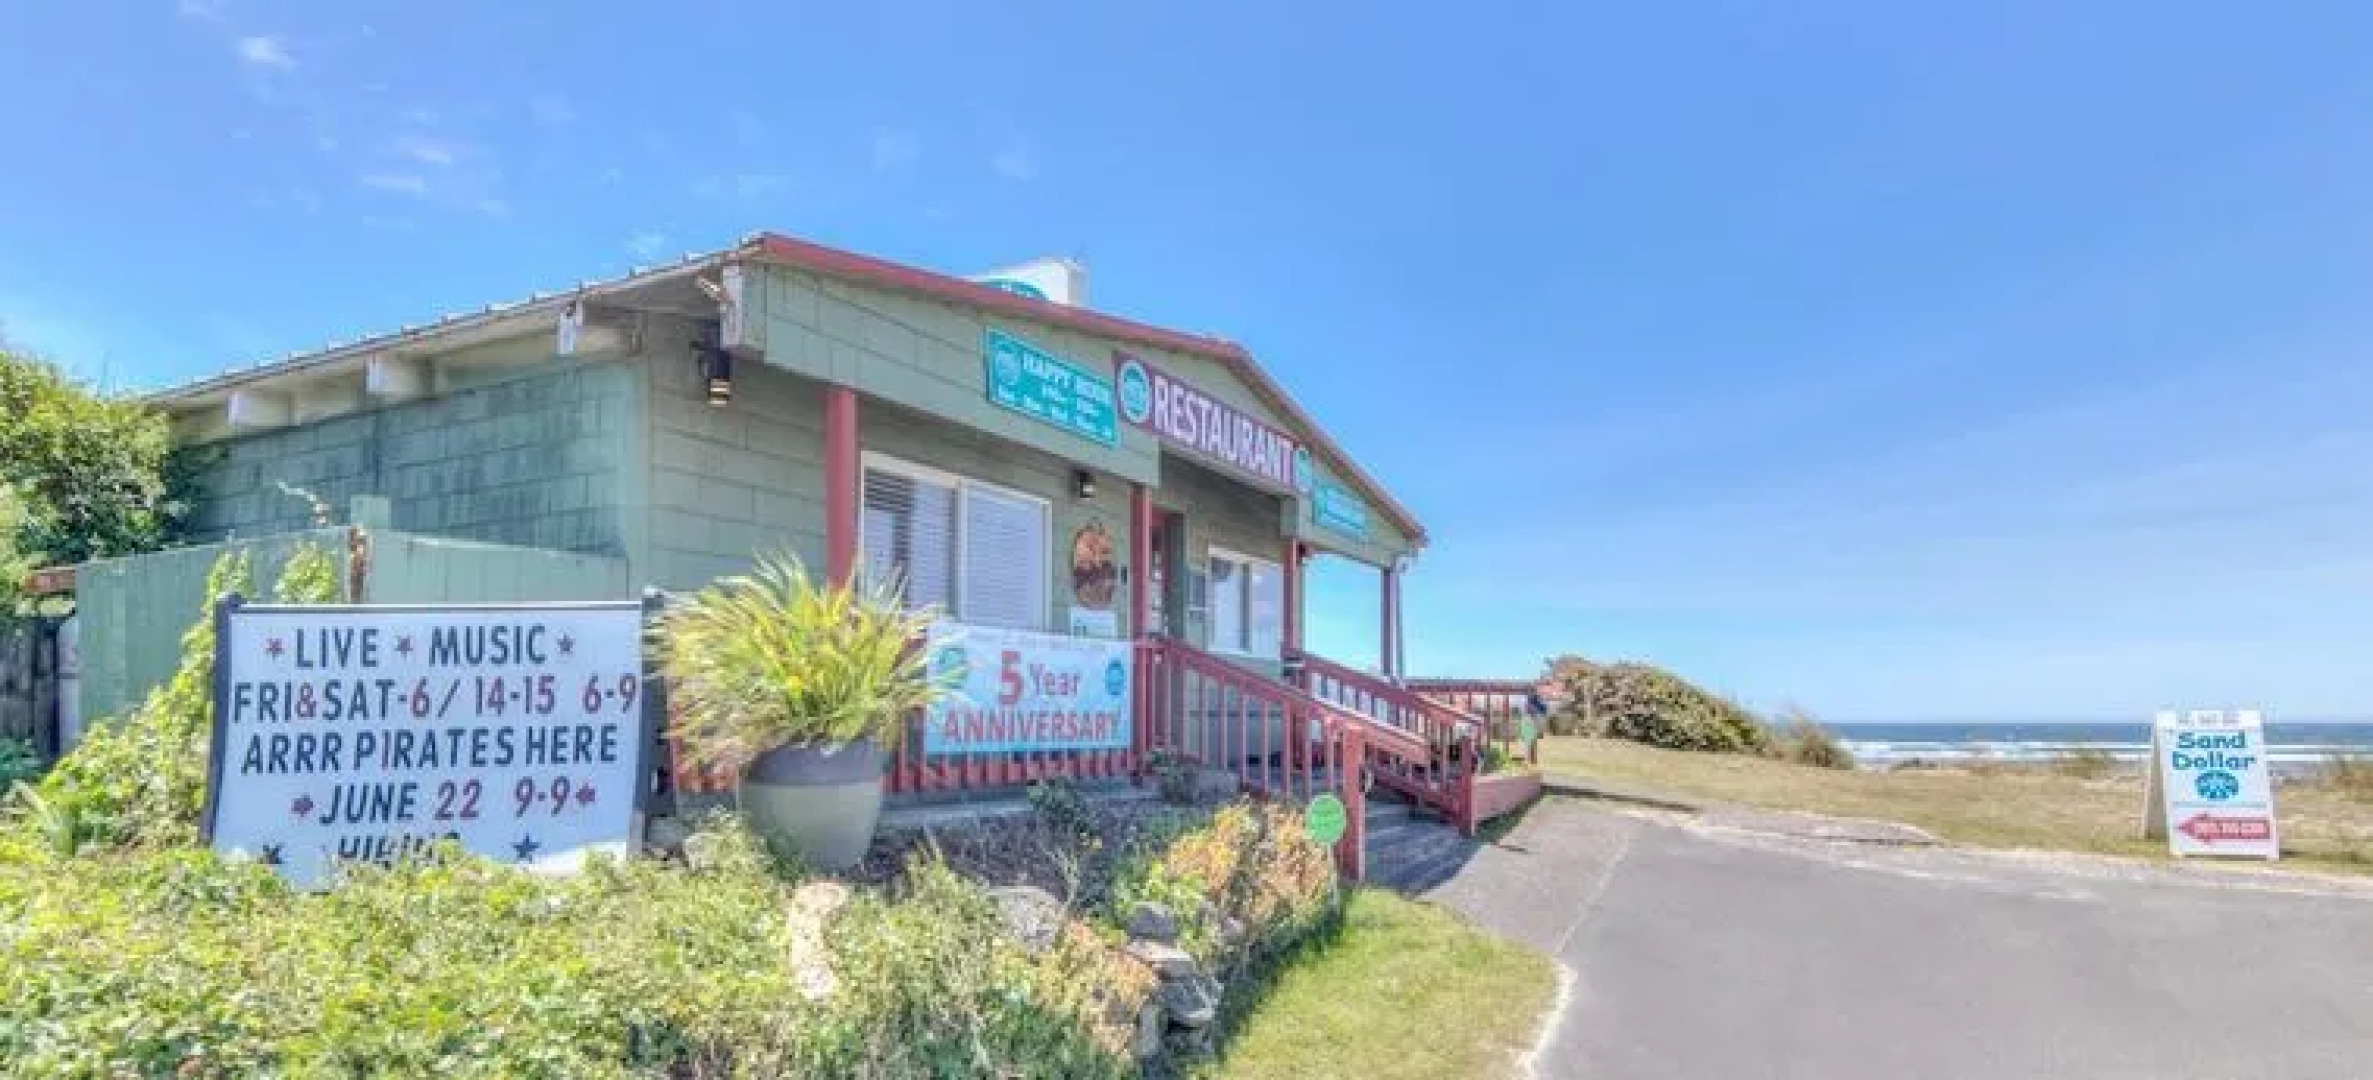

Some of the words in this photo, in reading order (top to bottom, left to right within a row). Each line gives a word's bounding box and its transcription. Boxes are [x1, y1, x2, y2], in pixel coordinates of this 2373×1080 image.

[1154, 374, 1293, 484] RESTAURANT
[296, 627, 379, 668] LIVE
[429, 625, 547, 667] MUSIC
[582, 673, 637, 713] 6-9
[998, 650, 1025, 705] 5
[1029, 662, 1081, 697] Year
[944, 708, 1121, 743] ANNIVERSARY
[2178, 730, 2246, 749] Sand
[241, 732, 342, 774] ARRR
[353, 727, 514, 770] PIRATES
[525, 724, 617, 765] HERE
[2172, 750, 2257, 770] Dollar
[319, 782, 418, 824] JUNE
[434, 779, 482, 820] 22
[515, 775, 571, 817] 9-9
